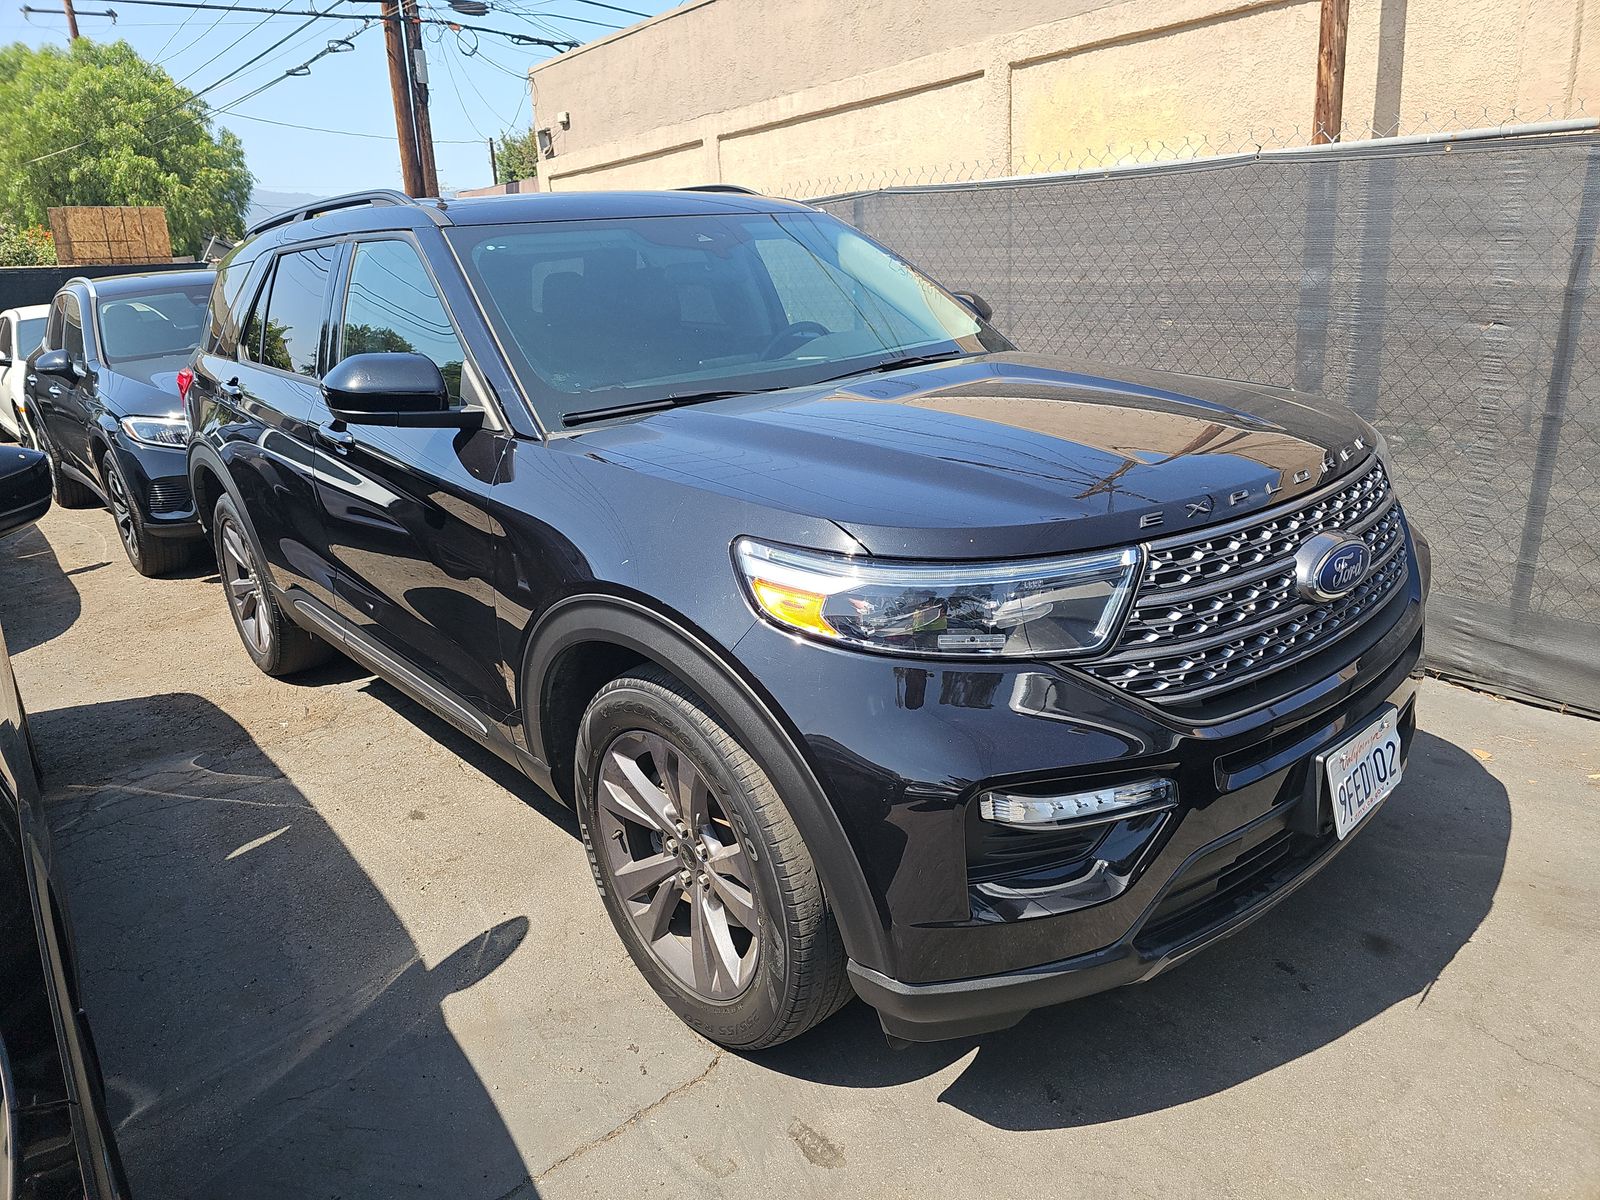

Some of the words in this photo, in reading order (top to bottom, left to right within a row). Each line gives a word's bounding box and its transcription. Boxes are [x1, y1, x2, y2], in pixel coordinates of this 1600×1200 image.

[1138, 435, 1366, 530] EXPLORER
[1332, 551, 1365, 588] Ford
[1338, 740, 1397, 825] 9FED102
